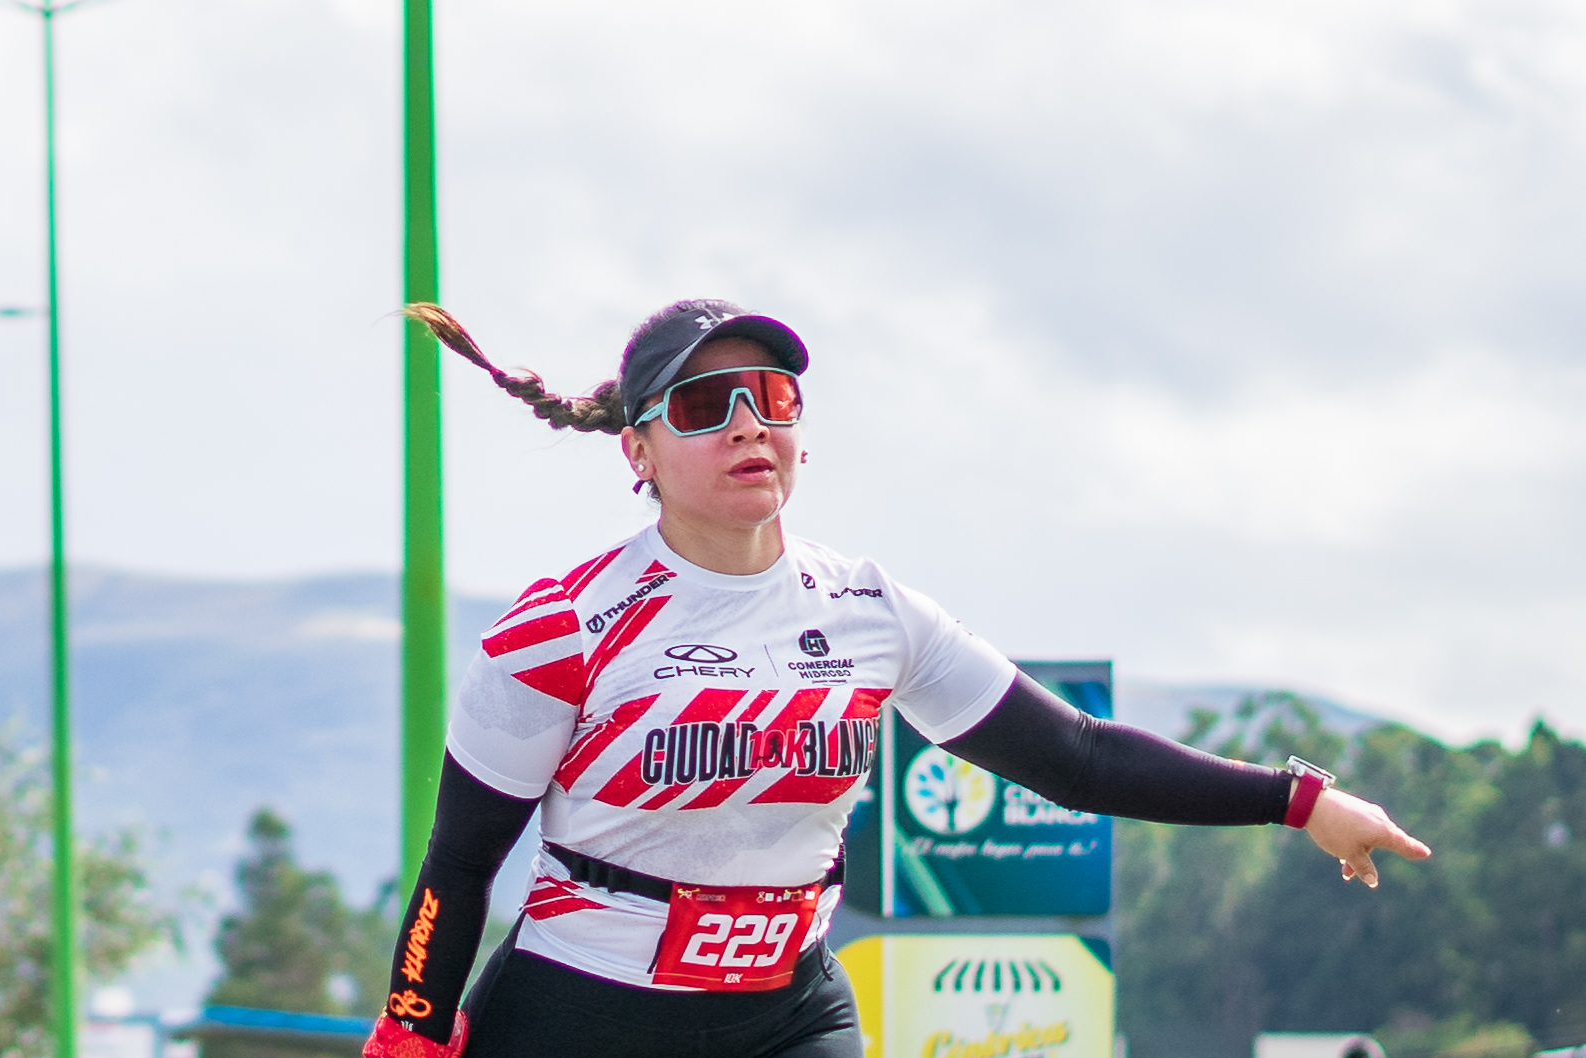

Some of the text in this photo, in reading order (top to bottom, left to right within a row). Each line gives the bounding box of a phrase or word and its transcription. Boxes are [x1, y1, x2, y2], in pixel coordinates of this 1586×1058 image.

[602, 574, 670, 619] THUNDER
[787, 658, 855, 671] COMERCIAL
[653, 665, 755, 680] CHERY
[798, 669, 852, 679] HIDROBO
[642, 720, 759, 785] CIUDAD
[796, 718, 878, 778] BLANC
[680, 912, 799, 967] 229
[723, 972, 744, 984] 10K
